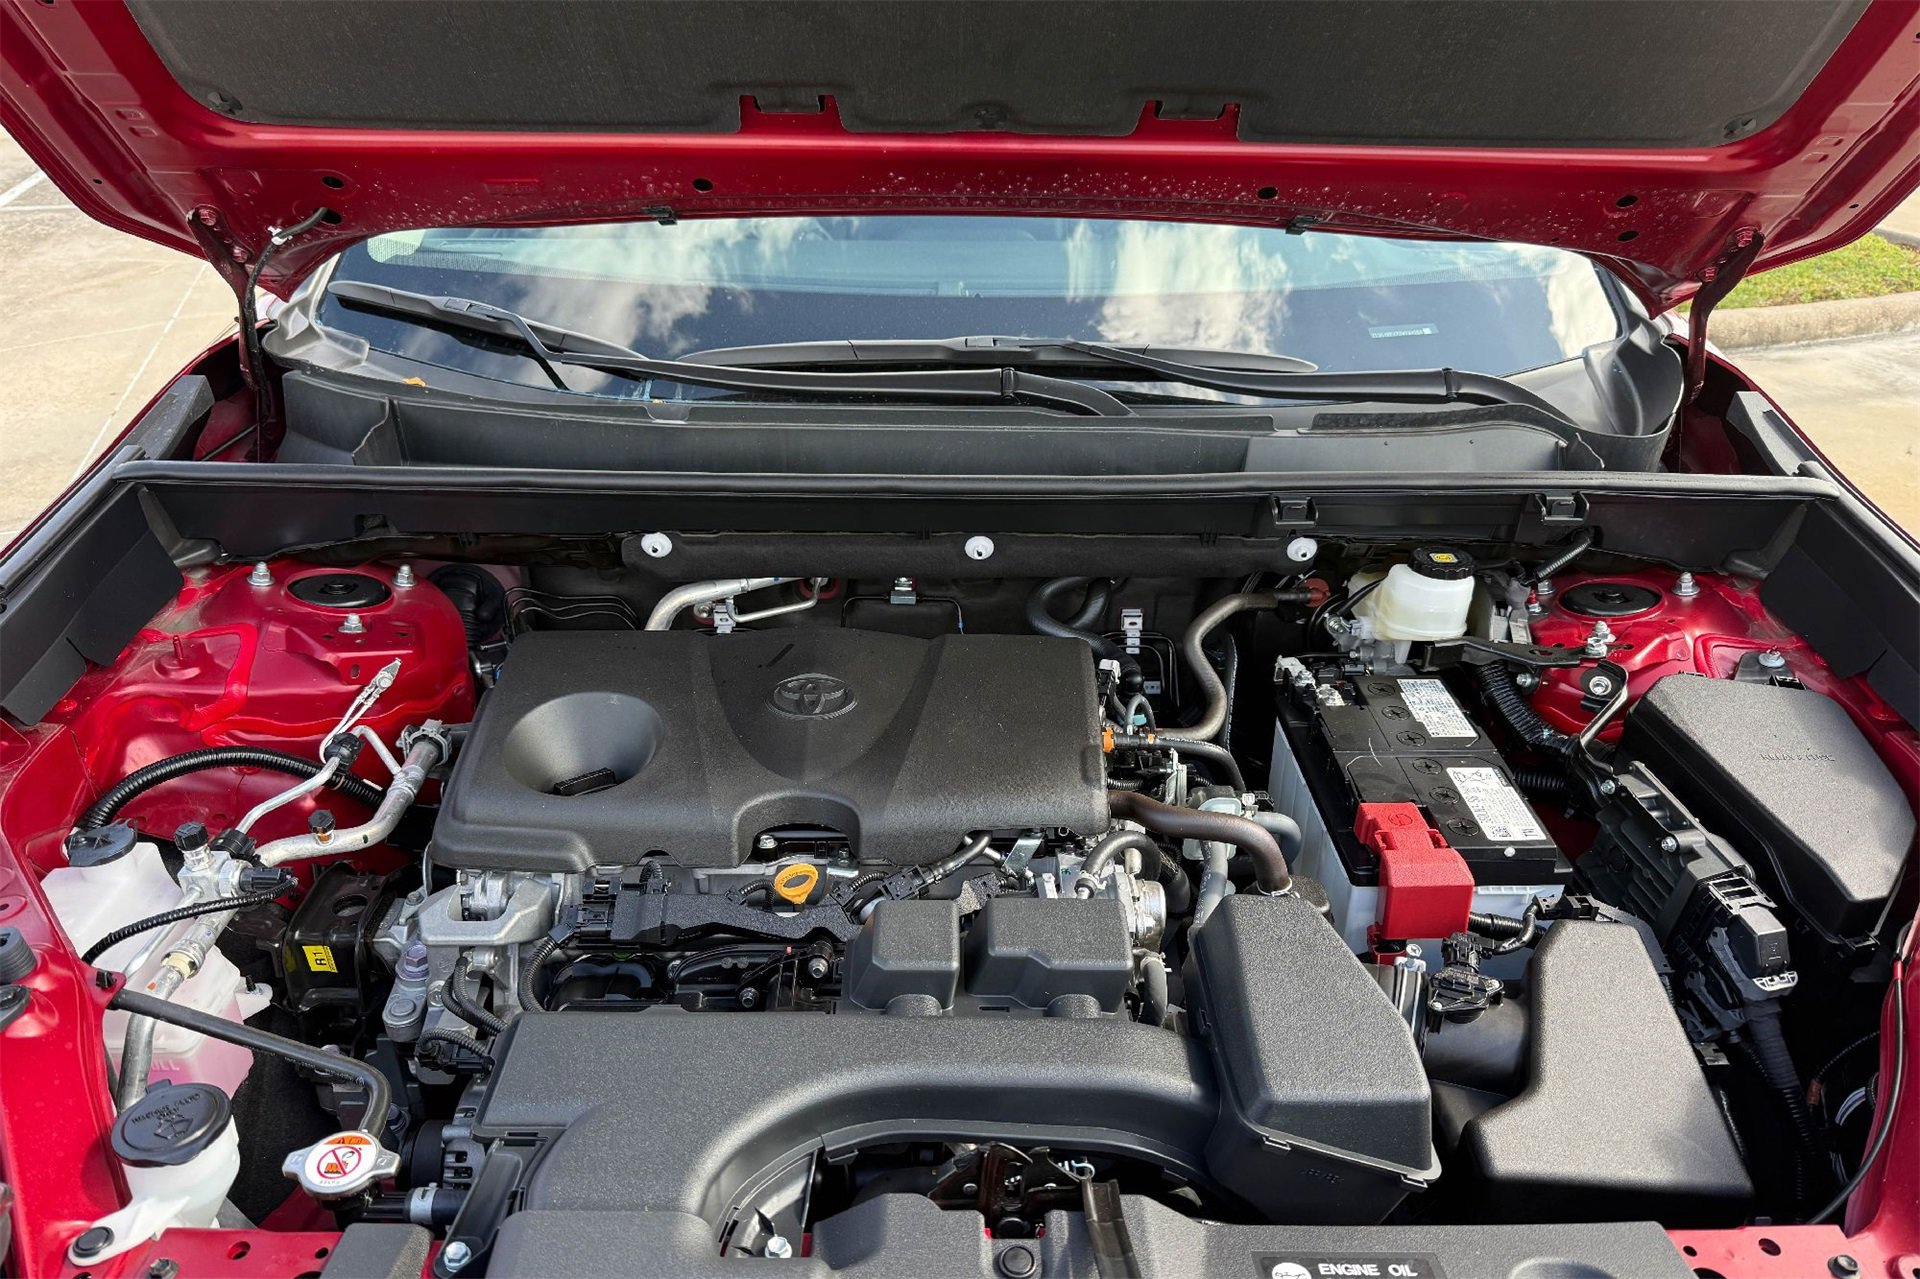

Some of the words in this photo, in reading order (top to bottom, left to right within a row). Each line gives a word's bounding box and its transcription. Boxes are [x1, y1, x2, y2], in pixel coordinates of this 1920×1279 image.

[312, 951, 327, 966] R1
[1318, 1263, 1381, 1276] ENGINE
[1387, 1264, 1419, 1277] OIL
